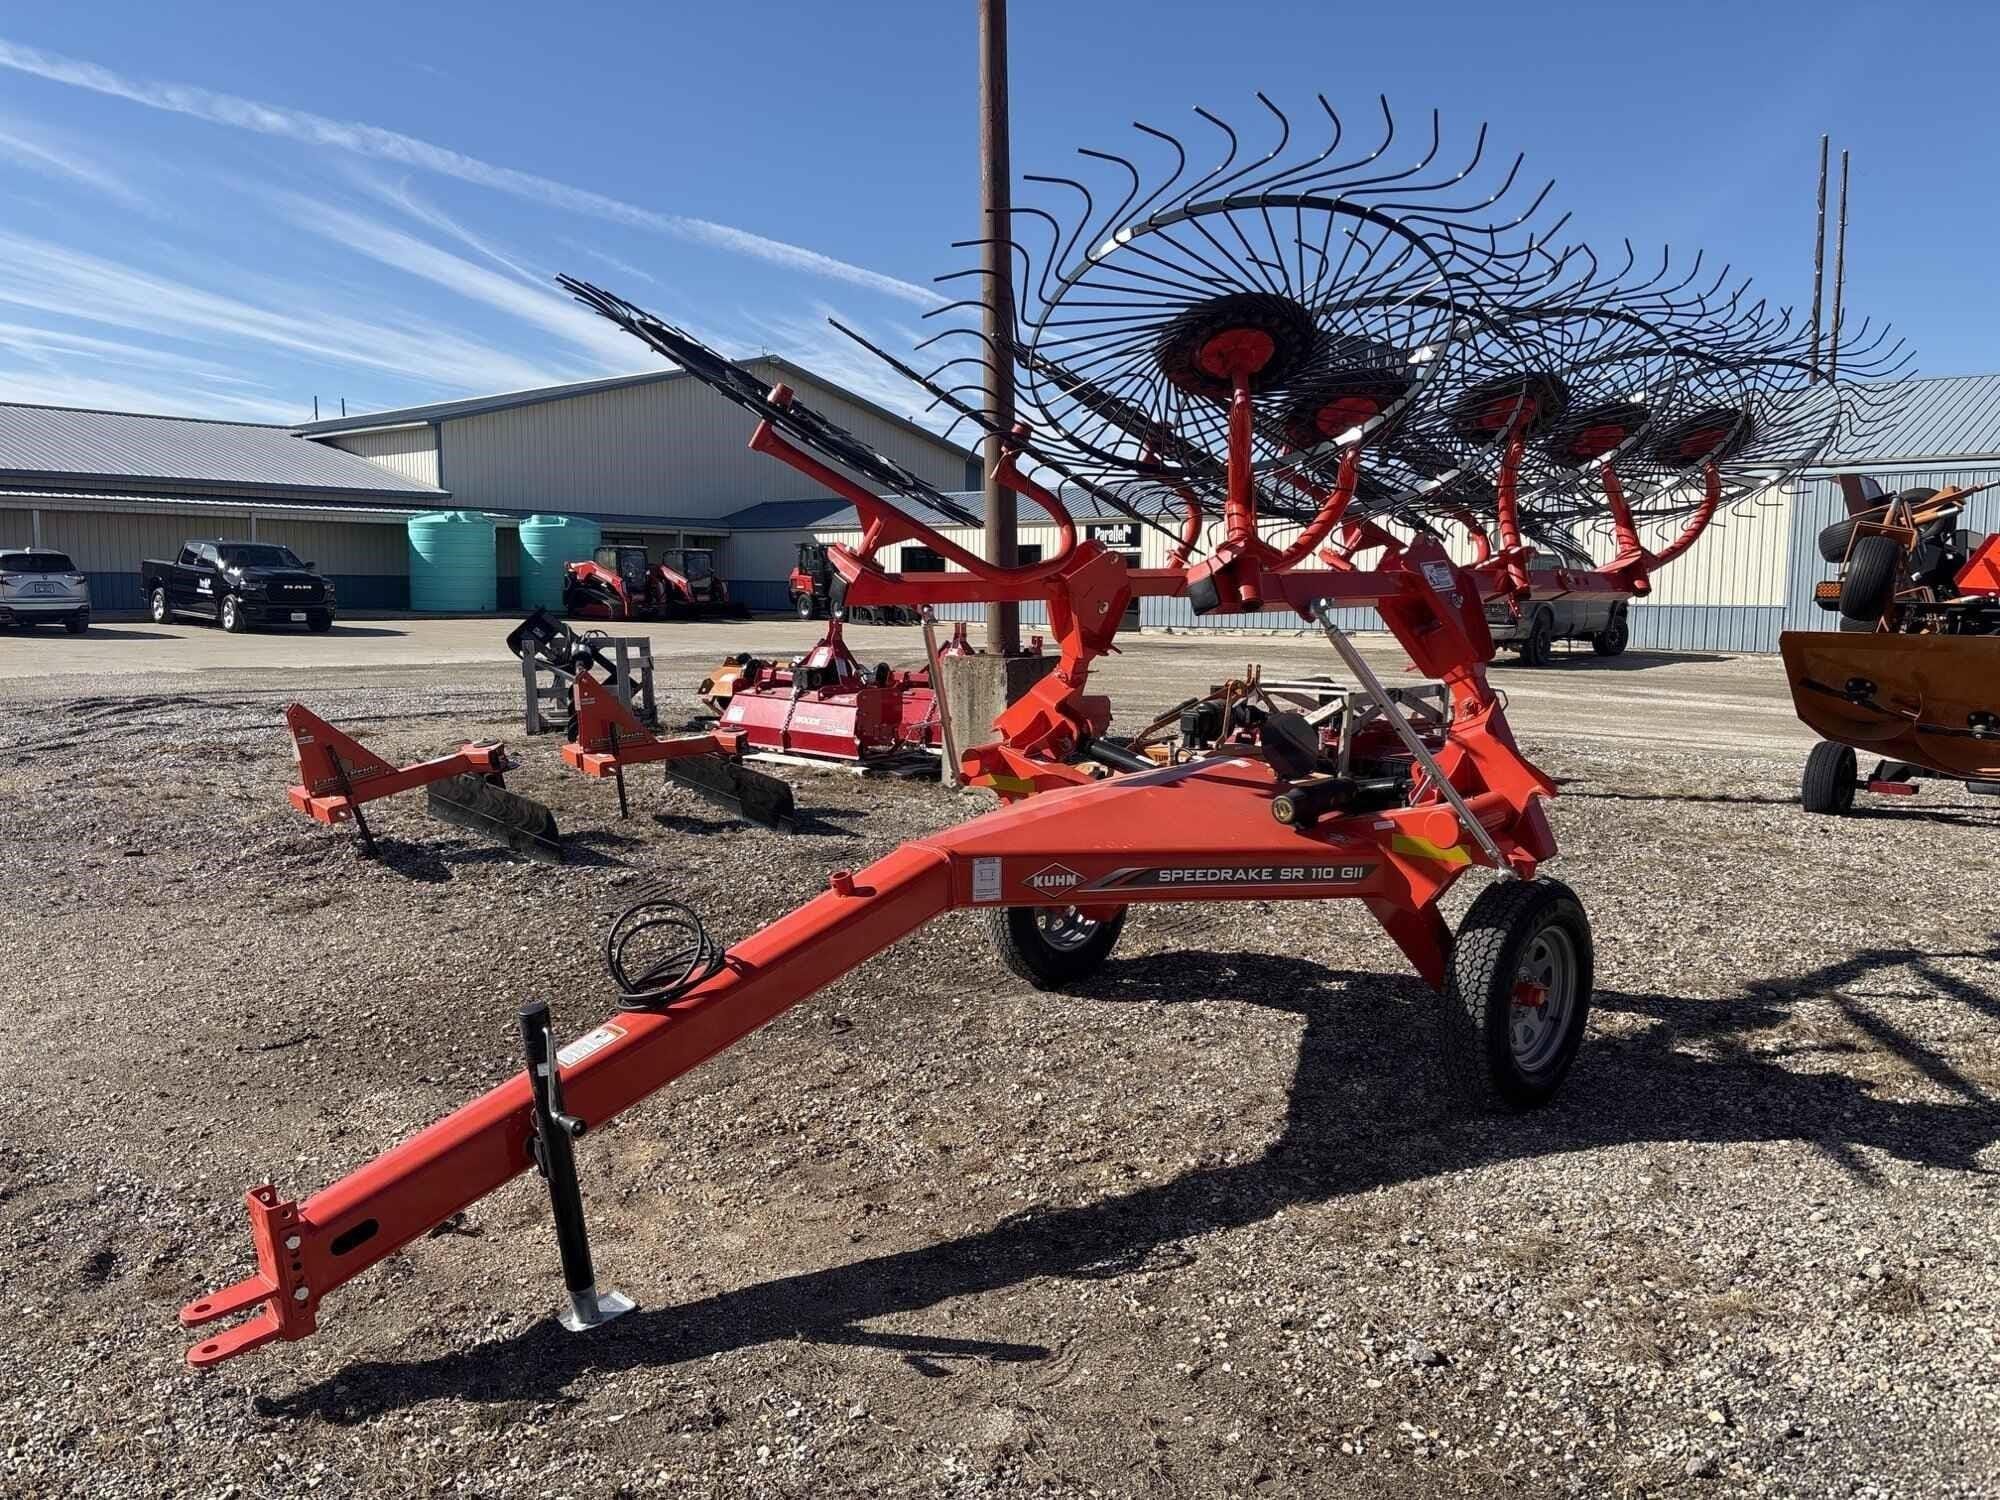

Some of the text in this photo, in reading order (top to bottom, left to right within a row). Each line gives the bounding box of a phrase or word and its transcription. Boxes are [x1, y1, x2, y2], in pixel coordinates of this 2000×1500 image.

[1033, 874, 1077, 888] KUHN
[1158, 868, 1273, 882] SPEEDRAKE
[1279, 867, 1304, 879] SR
[1311, 867, 1335, 879] 110
